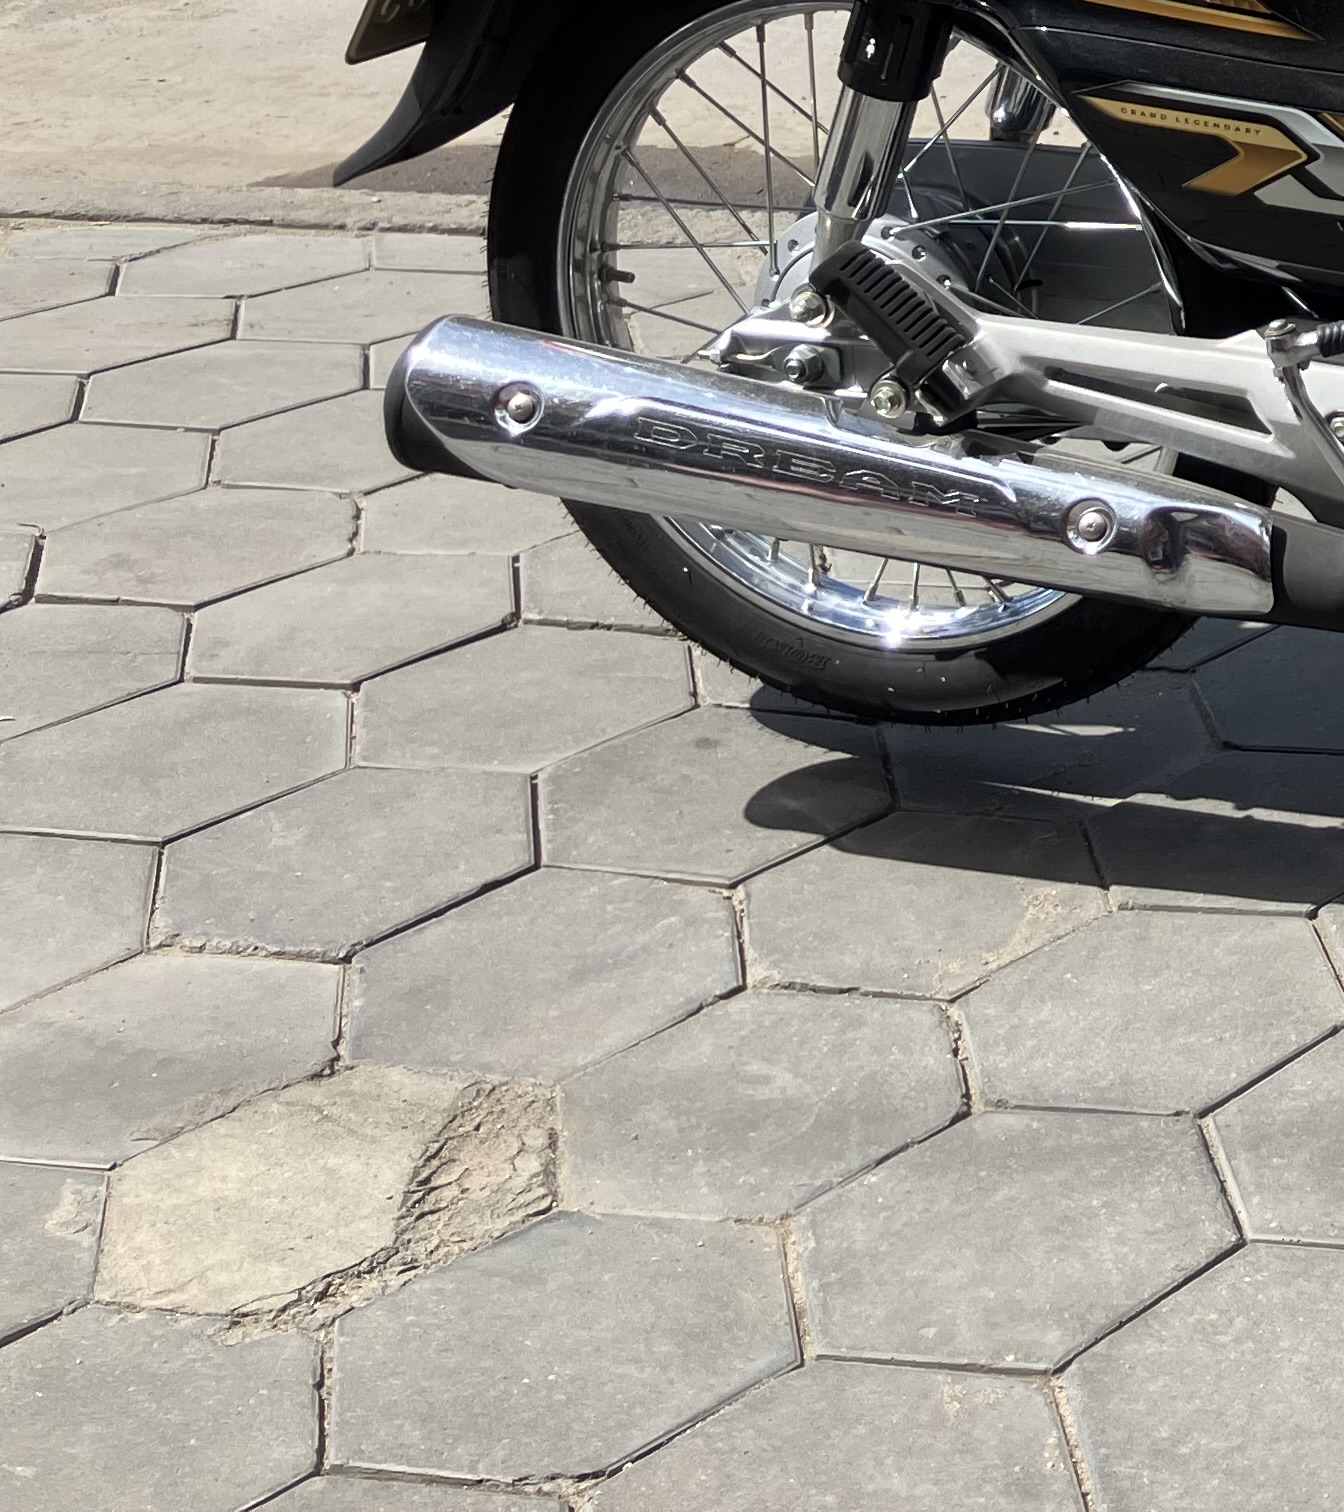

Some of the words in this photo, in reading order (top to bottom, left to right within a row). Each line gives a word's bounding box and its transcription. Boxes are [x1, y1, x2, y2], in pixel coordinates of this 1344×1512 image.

[1120, 106, 1168, 121] GRAND
[1175, 116, 1262, 136] LEGENDARY
[633, 416, 986, 519] DREAM
